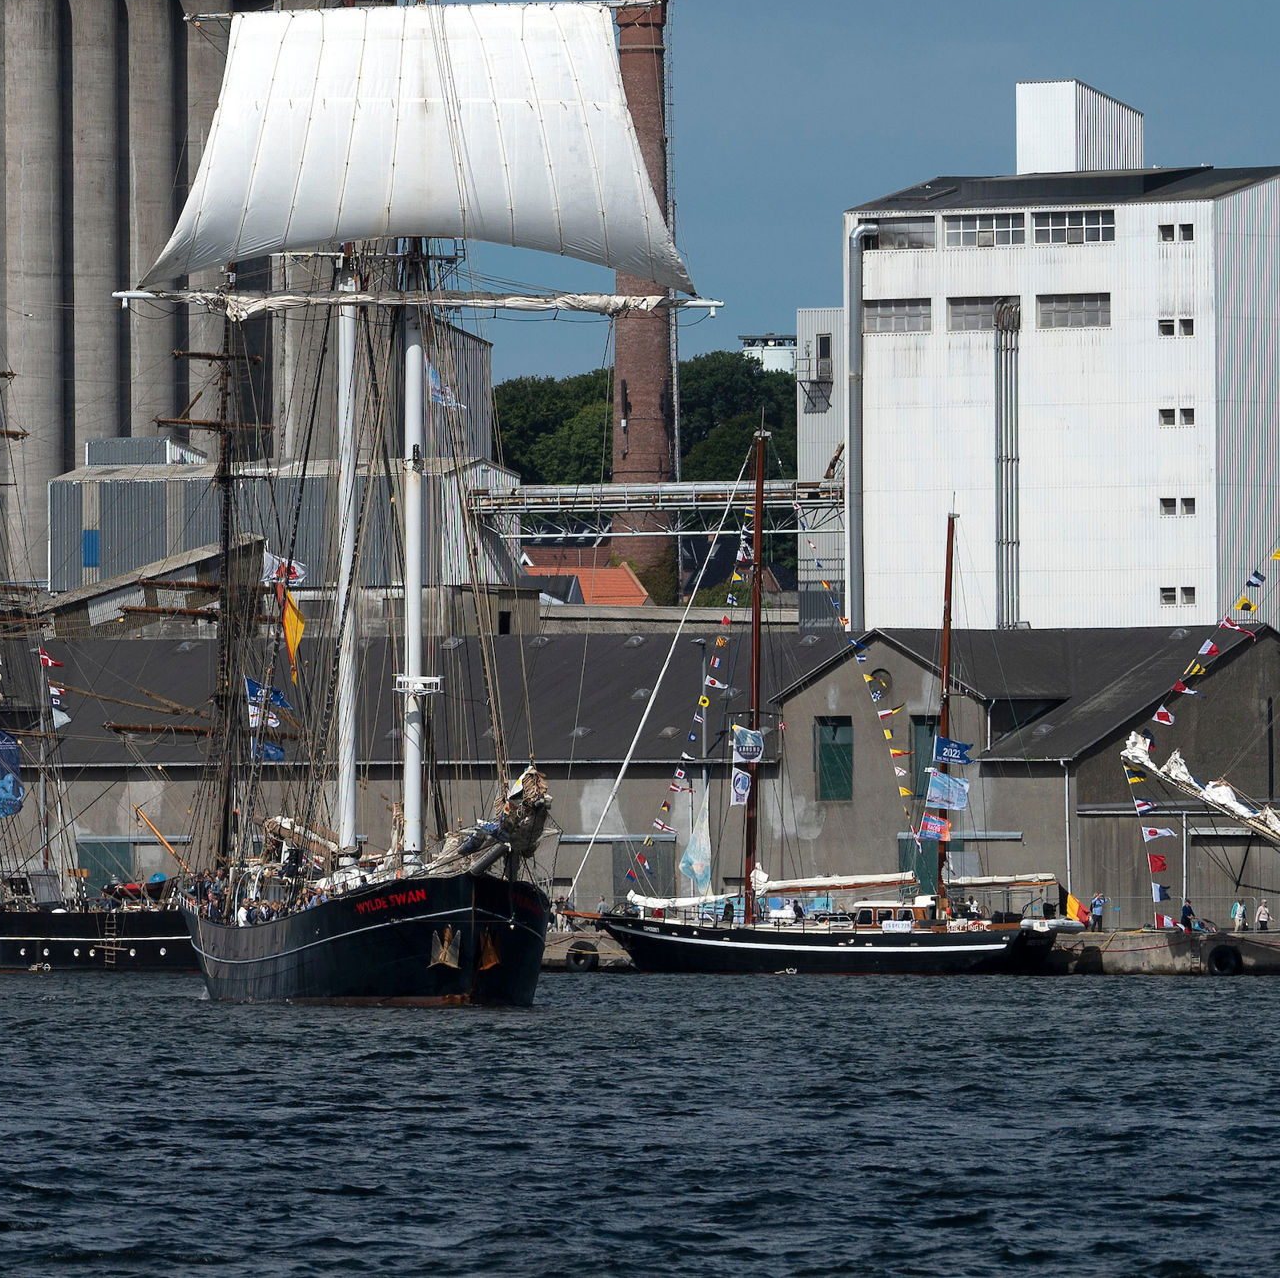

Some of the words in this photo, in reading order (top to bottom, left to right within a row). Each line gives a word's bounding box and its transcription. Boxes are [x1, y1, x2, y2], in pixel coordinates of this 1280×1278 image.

[942, 747, 961, 759] 2022
[356, 897, 388, 914] WYLDE
[389, 888, 427, 906] SWAN
